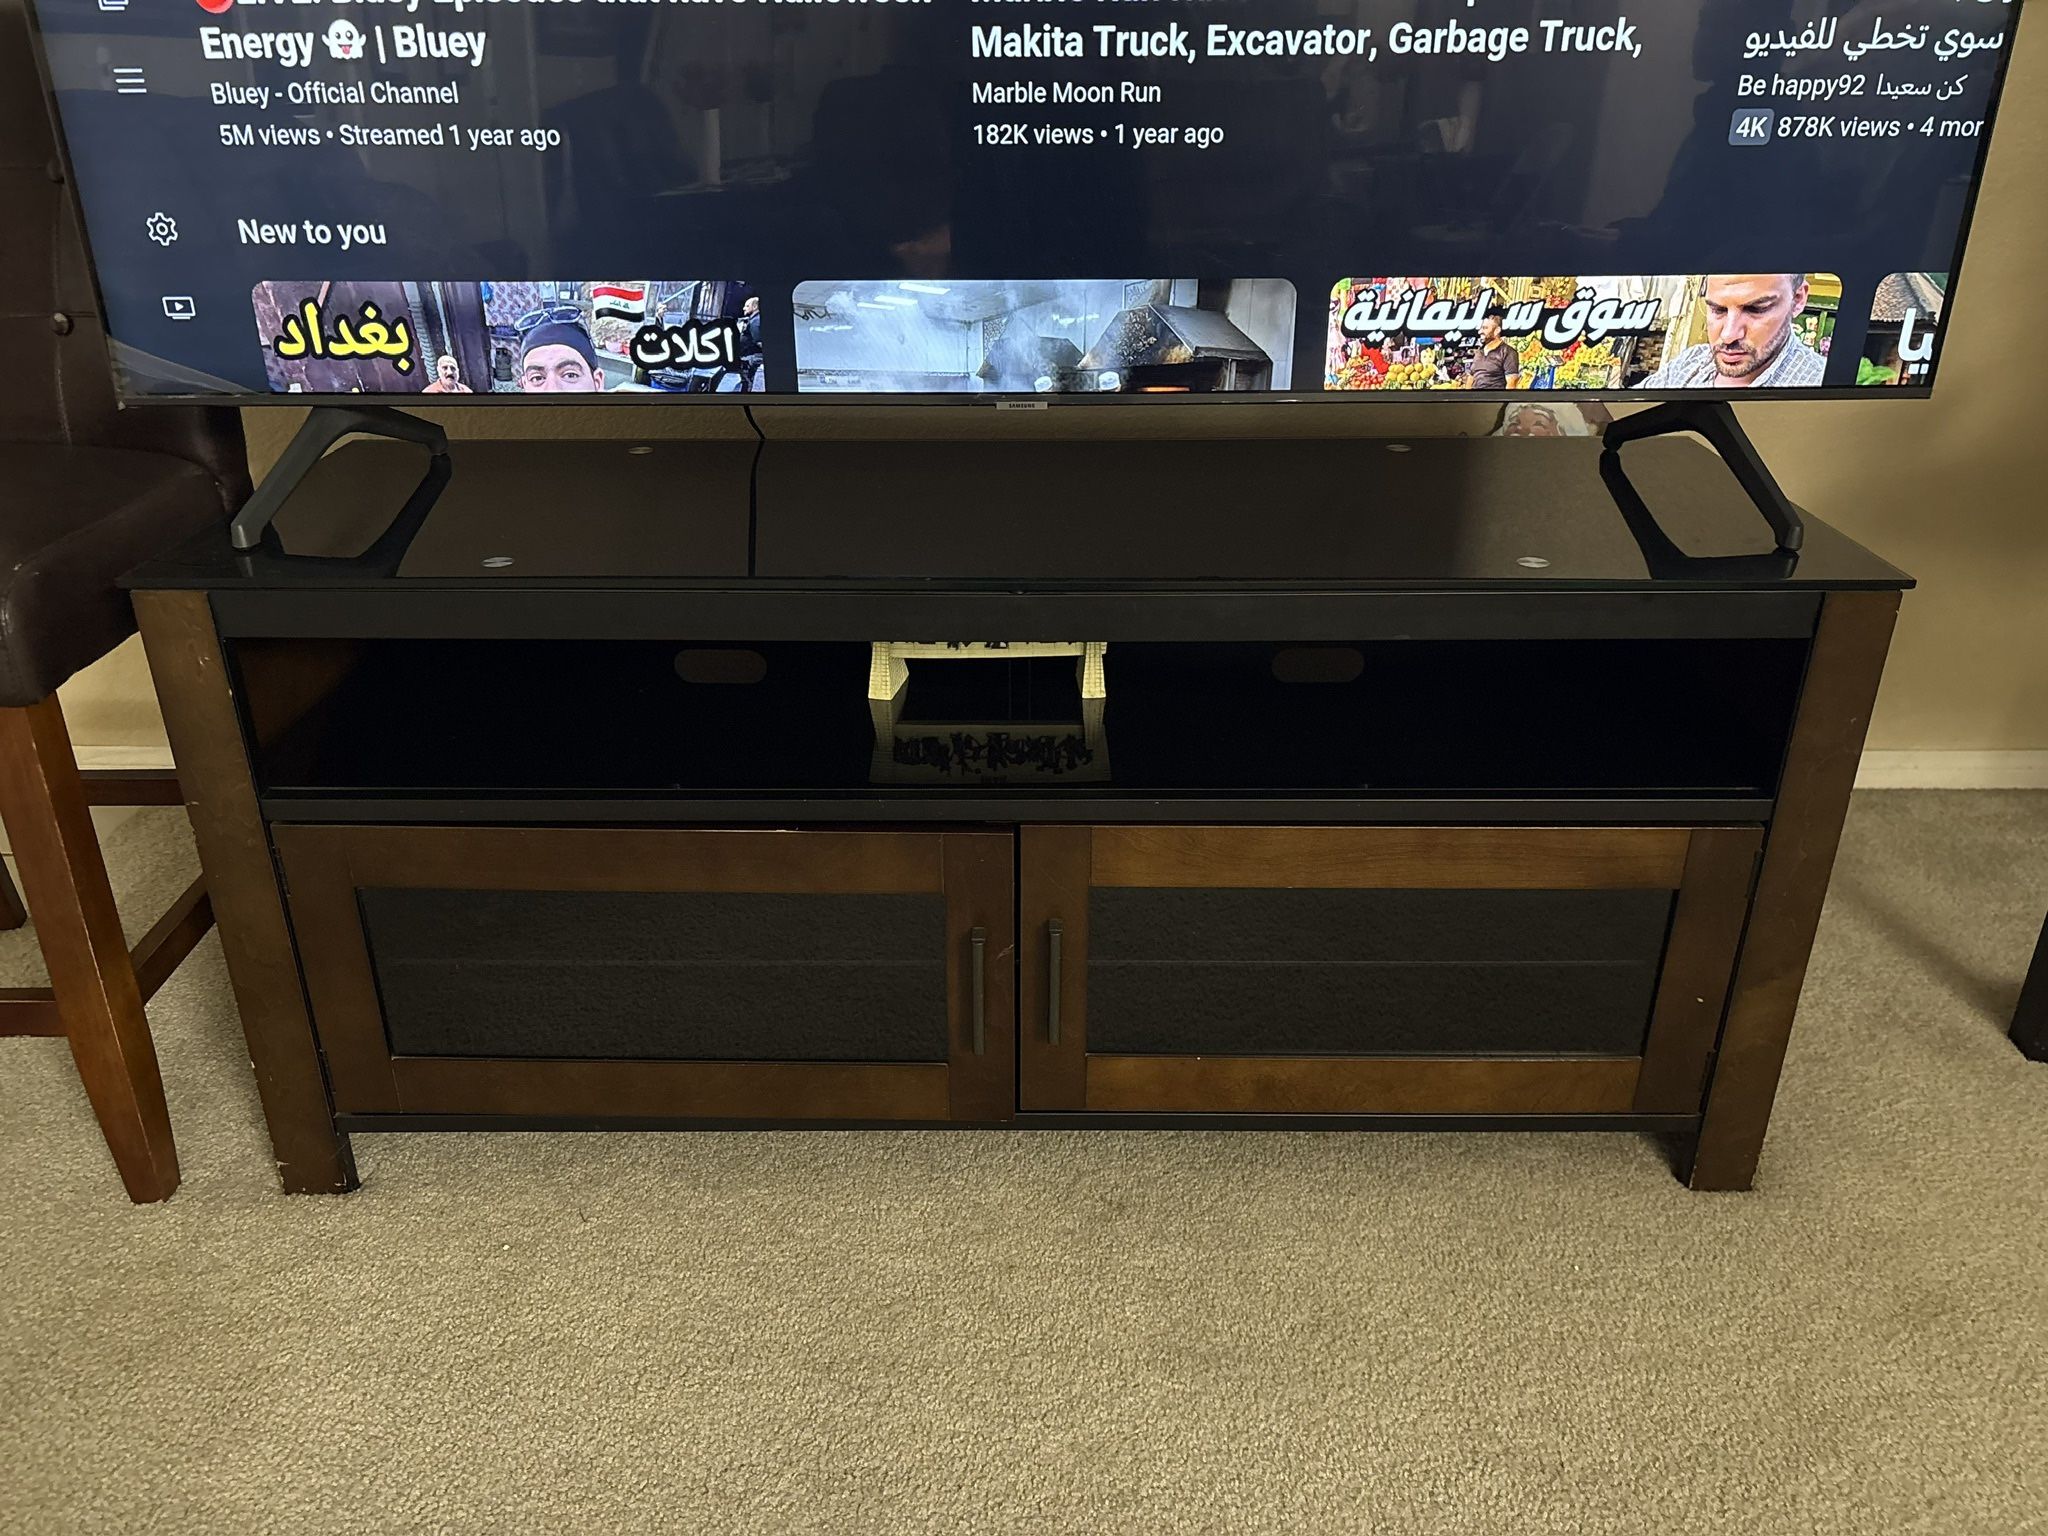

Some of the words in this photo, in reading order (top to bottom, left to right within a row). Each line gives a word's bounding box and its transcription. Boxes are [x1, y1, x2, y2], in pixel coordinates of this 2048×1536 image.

[200, 26, 314, 67] Energy
[392, 23, 486, 67] Bluey
[971, 23, 1084, 58] Makita
[1092, 22, 1196, 64] Truck,
[1206, 23, 1378, 62] Excavator,
[1388, 19, 1529, 62] Garbage
[1539, 16, 1642, 59] Truck,
[1743, 17, 1838, 58] للفيديو
[1843, 17, 1930, 61] تخطي
[210, 81, 269, 109] Bluey
[287, 81, 365, 104] Official
[369, 80, 459, 104] Channel
[972, 81, 1047, 103] Marble
[1053, 81, 1114, 103] Moon
[1120, 81, 1161, 103] Run
[1737, 75, 1767, 96] Be
[1771, 73, 1866, 101] happy92
[1876, 73, 1932, 100] سعيدا
[1936, 74, 1969, 101] كن
[219, 124, 254, 146] 5M
[258, 123, 321, 146] views
[338, 122, 444, 146] Streamed
[448, 124, 460, 146] 1
[466, 128, 515, 151] year
[520, 128, 561, 152] ago
[973, 123, 1029, 145] 182K
[1033, 123, 1094, 145] views
[1114, 123, 1124, 144] 1
[1132, 127, 1179, 149] year
[1183, 127, 1224, 149] ago
[1735, 116, 1768, 138] 4K
[1777, 116, 1836, 137] 878K
[1840, 116, 1901, 137] views
[1919, 116, 1935, 137] 4
[237, 218, 297, 245] New
[302, 219, 332, 245] to
[336, 224, 387, 251] you
[1543, 286, 1660, 345] سوق
[276, 301, 411, 373] بغداد
[635, 326, 735, 364] اكلات
